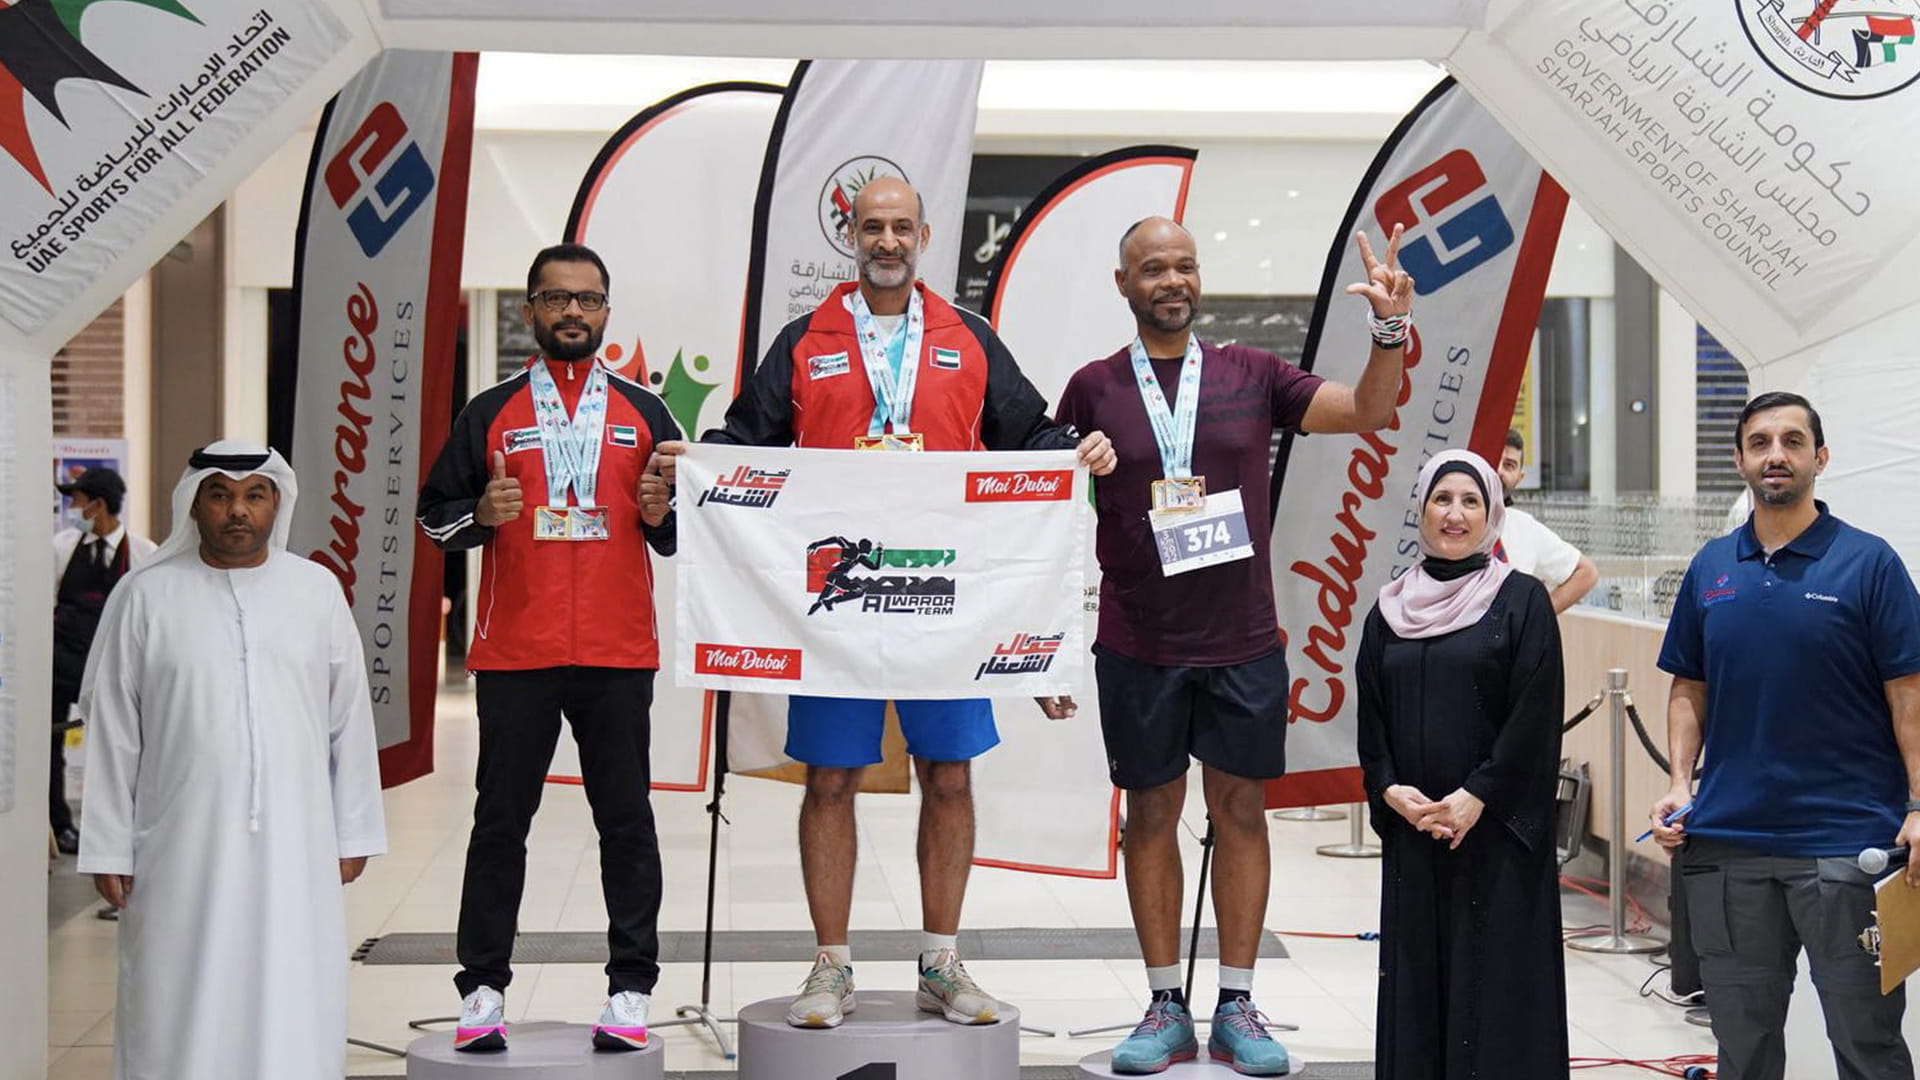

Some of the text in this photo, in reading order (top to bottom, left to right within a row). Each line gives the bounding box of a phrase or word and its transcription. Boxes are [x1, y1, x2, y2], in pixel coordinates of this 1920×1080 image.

[226, 9, 274, 59] اتحاد
[1763, 13, 1793, 47] Sharjah
[1578, 16, 1838, 247] مجلس الشارقة الرياضي
[1624, 0, 1871, 218] حكومة الشارق
[26, 26, 292, 274] UAE SPORTS FOR ALL FEDERATION
[75, 117, 156, 192] للرياضة
[1535, 56, 1782, 292] SHARJAH SPORTS COUNCIL
[1553, 39, 1809, 277] GOVERNMENT OF SHARJAH
[10, 189, 80, 260] للجميع
[976, 473, 1061, 496] Mai Dubai
[1183, 520, 1232, 553] 374
[891, 595, 956, 607] WARQA
[916, 607, 954, 616] TEAM
[705, 648, 790, 671] Mai Dubai
